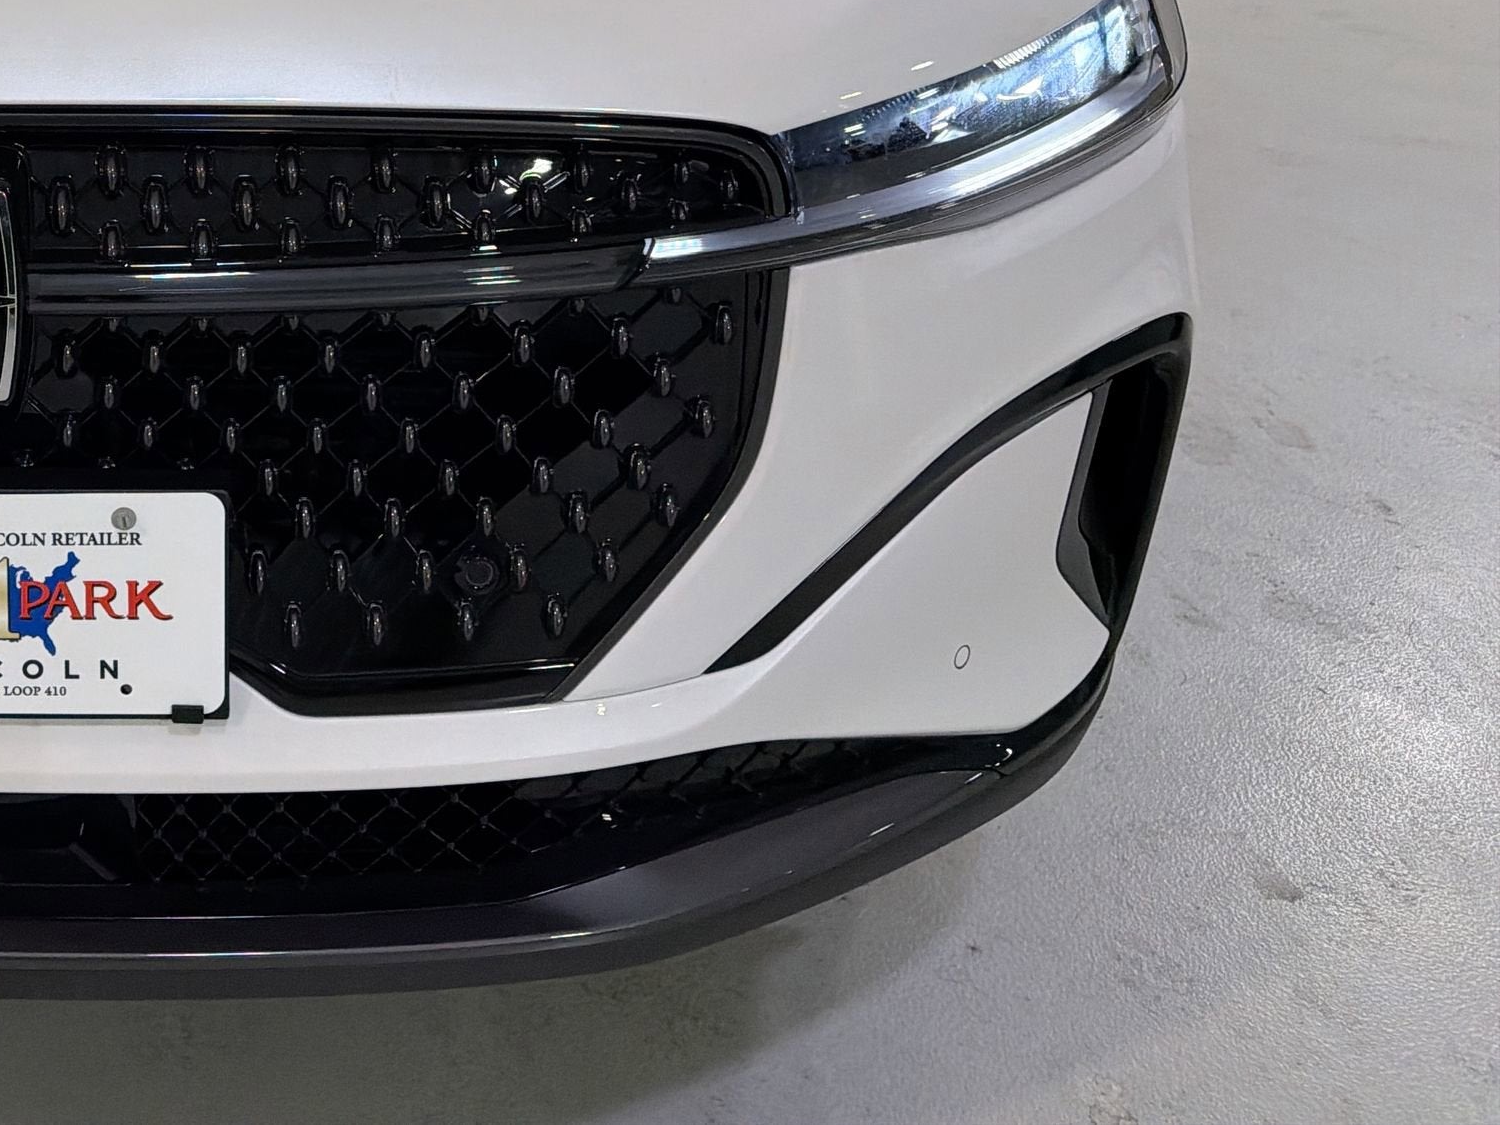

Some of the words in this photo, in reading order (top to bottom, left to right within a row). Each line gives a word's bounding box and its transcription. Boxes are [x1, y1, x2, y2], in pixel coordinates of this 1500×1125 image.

[51, 532, 142, 547] RETAILER
[18, 580, 174, 620] PARK
[3, 686, 42, 697] LOOP
[44, 686, 67, 697] 410
